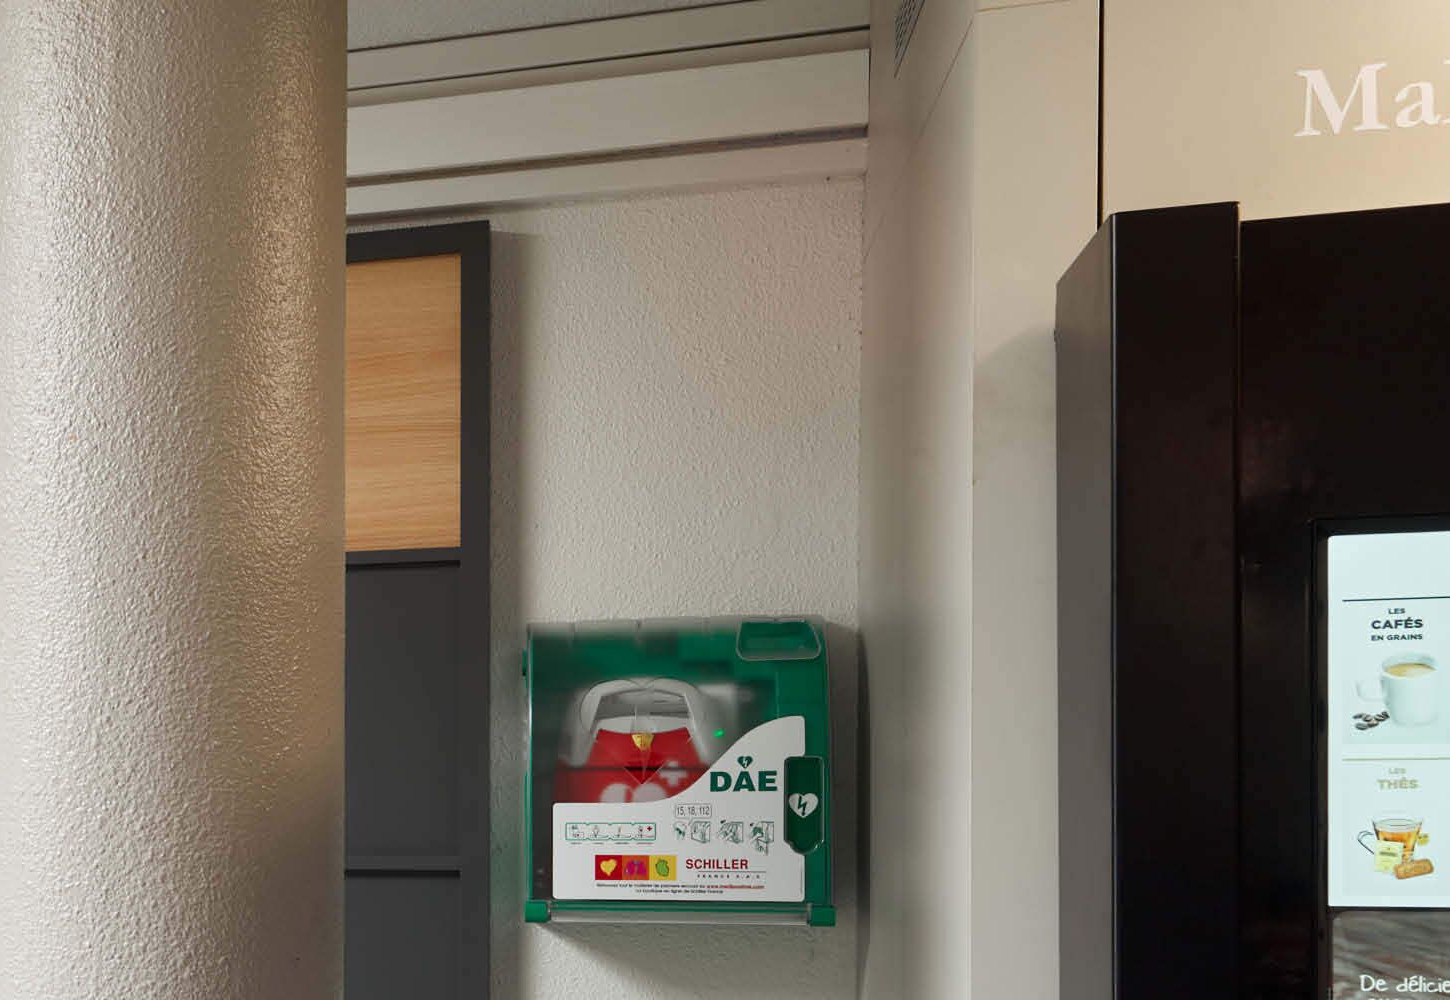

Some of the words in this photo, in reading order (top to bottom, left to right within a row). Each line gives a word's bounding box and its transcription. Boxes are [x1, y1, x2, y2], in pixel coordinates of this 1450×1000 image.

[1294, 59, 1450, 136] Ma
[1371, 617, 1423, 630] CAFÉS
[709, 770, 778, 792] DAE
[1377, 777, 1420, 790] THÉS
[685, 859, 749, 870] SCHILLER
[1359, 974, 1388, 992] De
